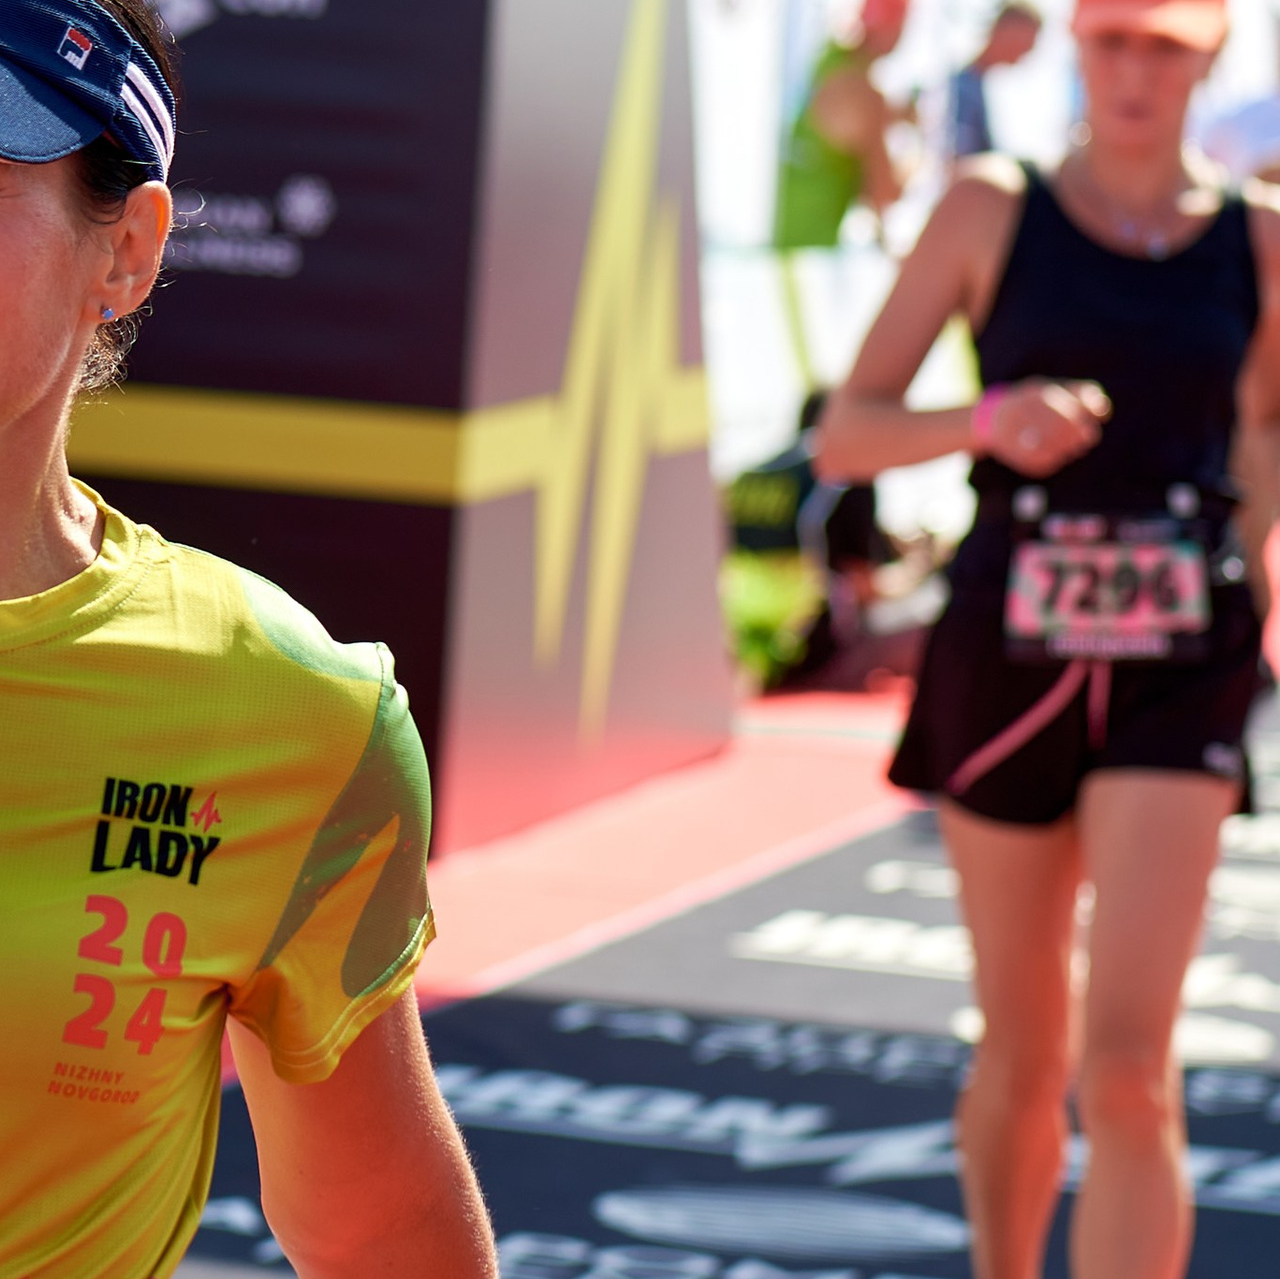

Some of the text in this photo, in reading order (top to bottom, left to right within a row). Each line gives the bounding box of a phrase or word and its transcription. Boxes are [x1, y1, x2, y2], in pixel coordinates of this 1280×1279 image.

[1042, 558, 1184, 618] 7296
[101, 777, 194, 827] IRON
[90, 819, 221, 886] LADY
[46, 1080, 140, 1105] NOVGOROD
[53, 1062, 125, 1086] NIZHNY
